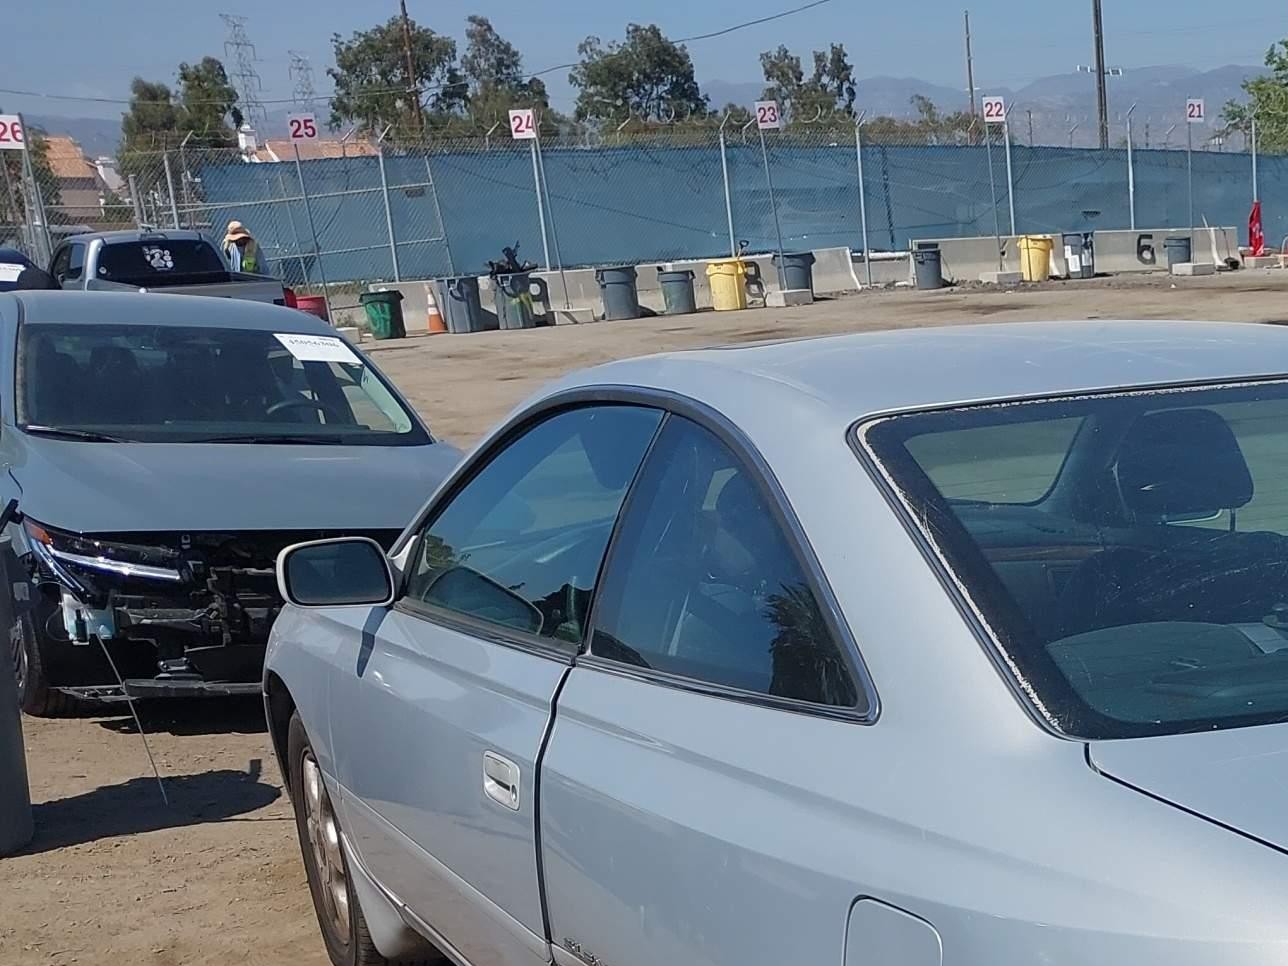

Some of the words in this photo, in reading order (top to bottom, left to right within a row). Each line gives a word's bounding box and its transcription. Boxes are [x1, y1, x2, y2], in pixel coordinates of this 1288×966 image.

[757, 106, 778, 124] 23
[984, 102, 1004, 117] 22
[1188, 103, 1203, 118] 21
[289, 119, 316, 138] 25
[512, 115, 534, 133] 24
[1137, 234, 1156, 265] 6
